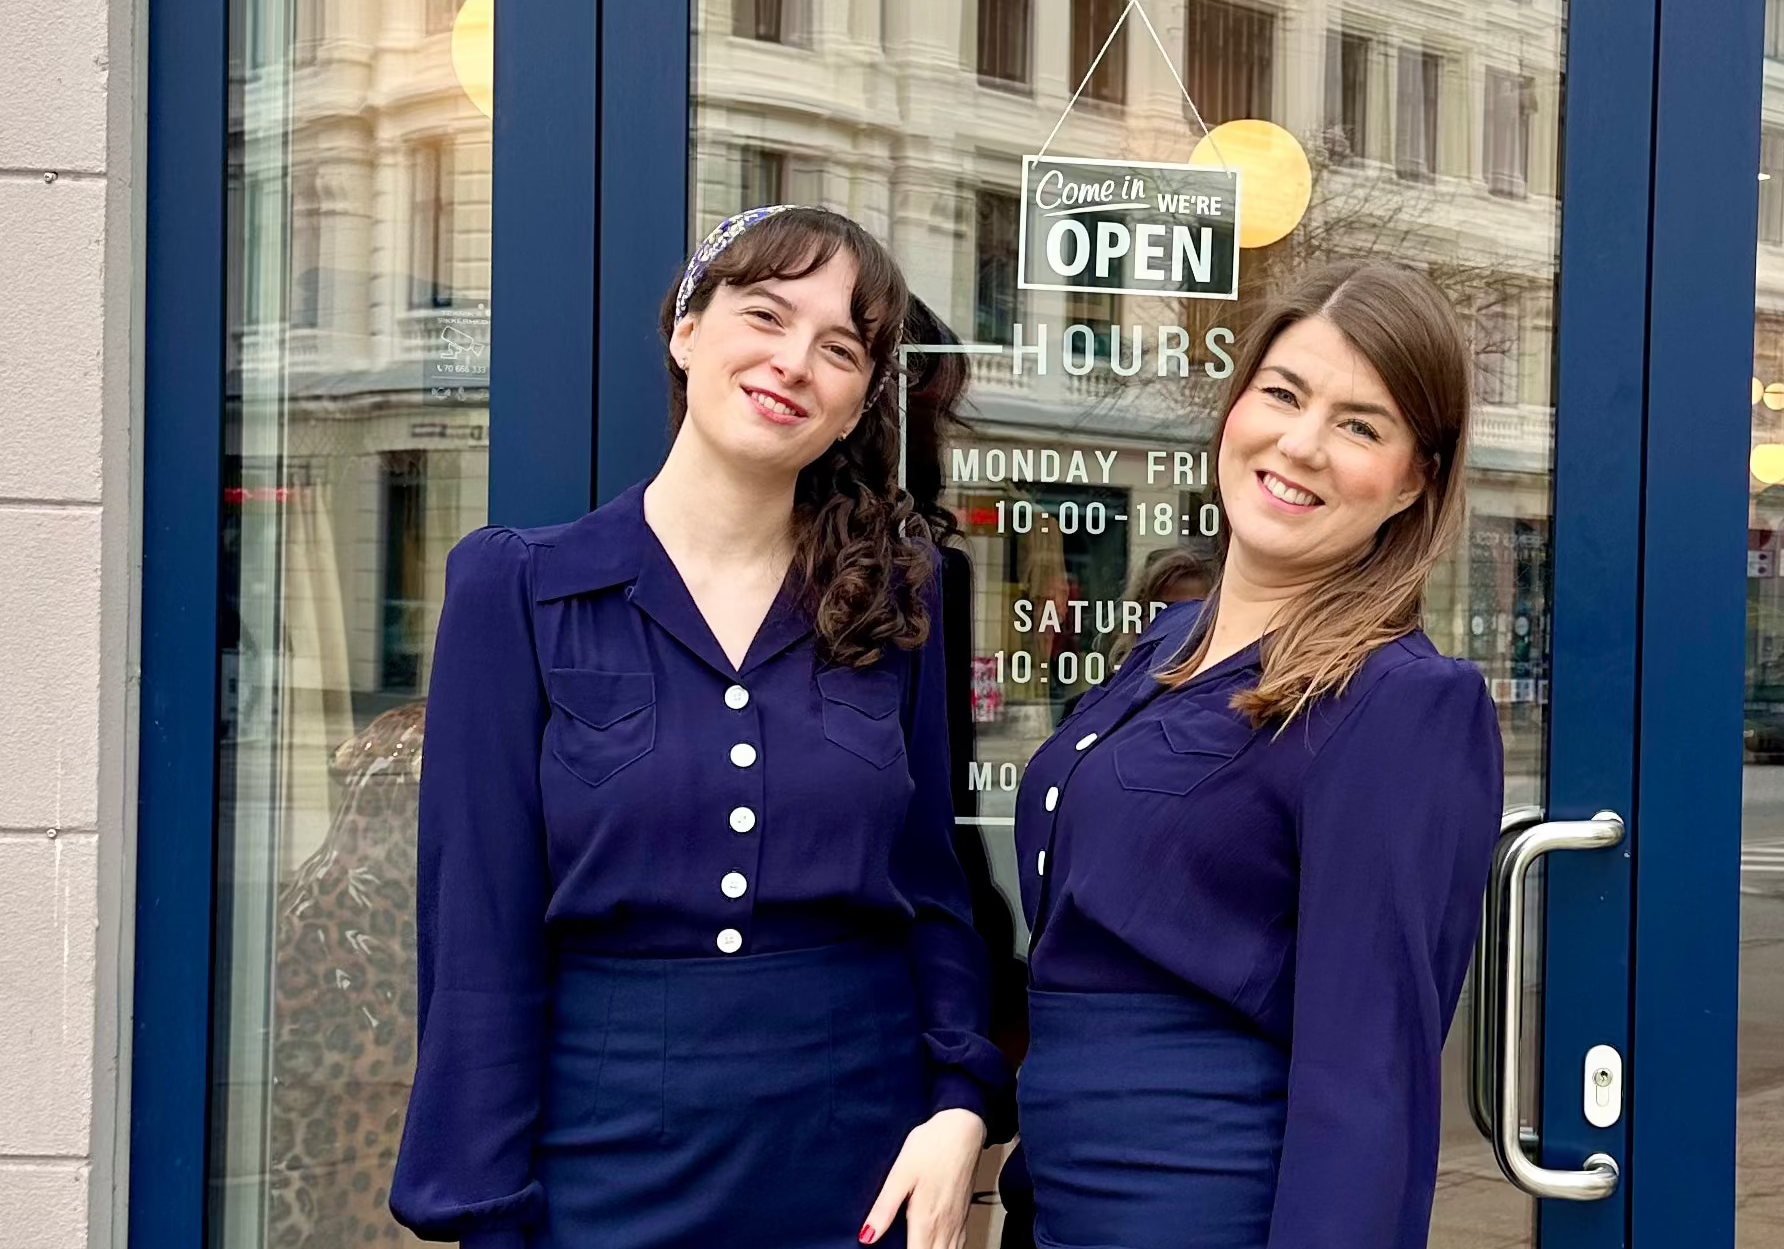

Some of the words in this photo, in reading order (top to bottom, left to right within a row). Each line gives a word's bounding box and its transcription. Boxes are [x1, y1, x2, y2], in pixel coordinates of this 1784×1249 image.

[1035, 170, 1115, 210] Come
[1121, 176, 1146, 200] in
[1157, 193, 1222, 216] WE'RE
[1046, 219, 1213, 283] OPEN
[1012, 323, 1236, 379] HOURS
[951, 448, 1118, 484] MONDAY
[1146, 450, 1209, 485] FRI
[995, 500, 1220, 536] 10:00-18:0
[1013, 599, 1168, 634] SATUR
[994, 650, 1122, 685] 10:00-
[968, 761, 1022, 792] MO
